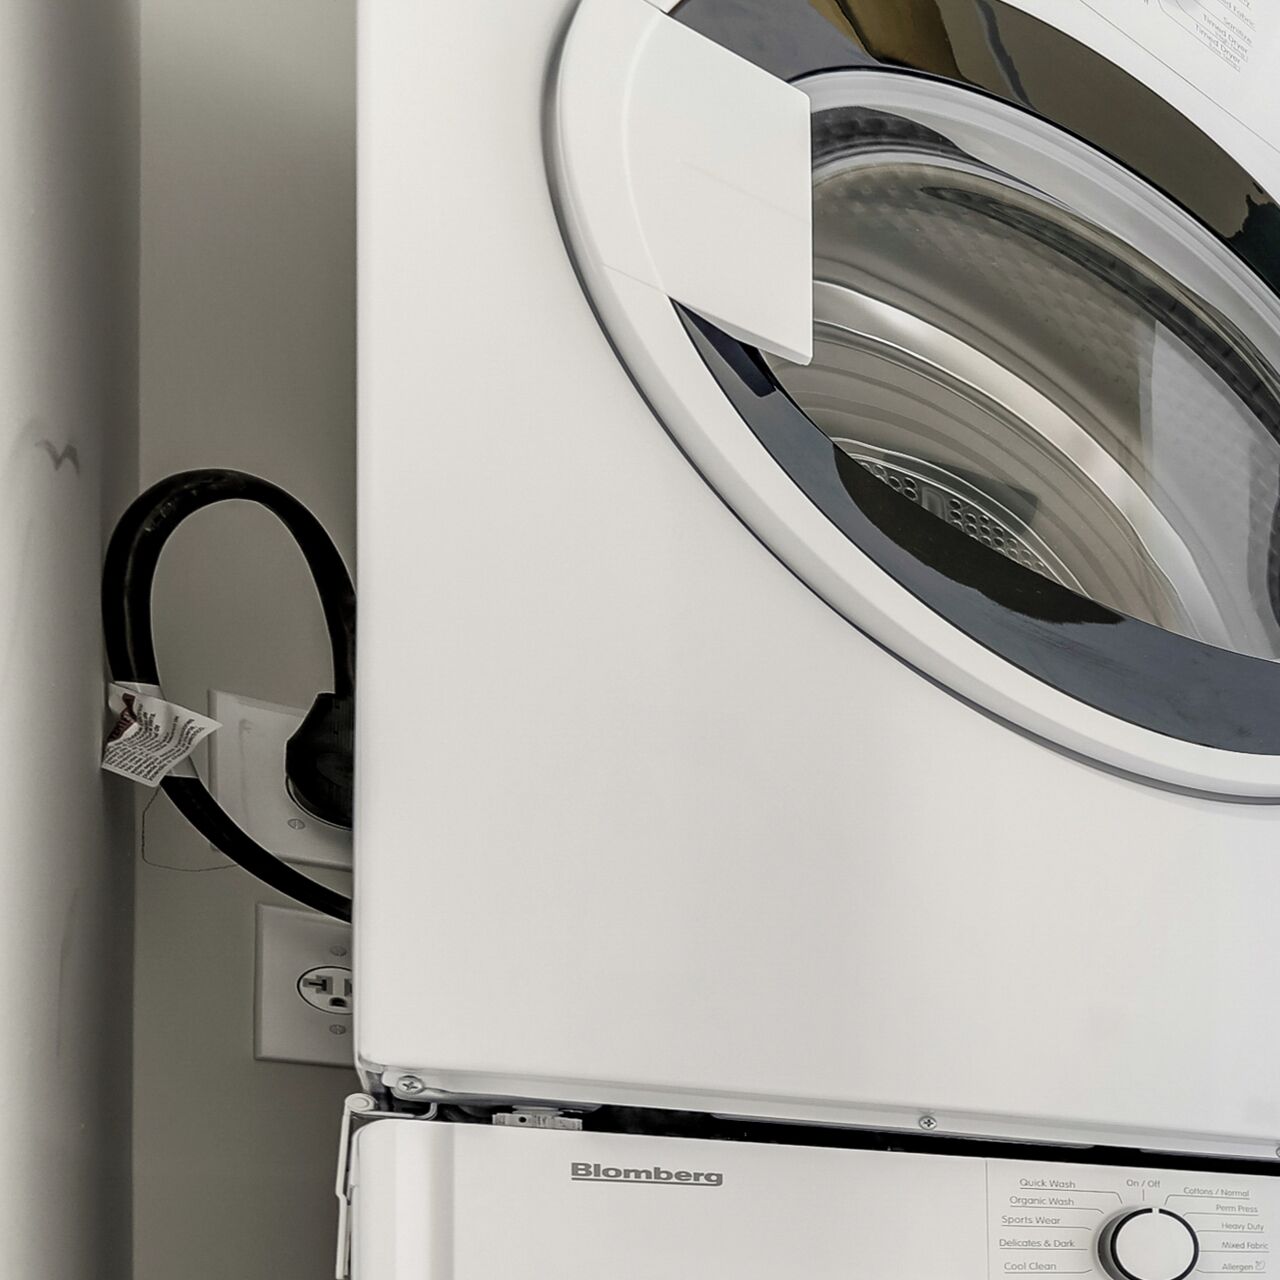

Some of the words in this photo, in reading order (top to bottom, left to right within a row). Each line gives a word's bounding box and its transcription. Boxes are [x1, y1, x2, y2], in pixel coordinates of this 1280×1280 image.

[1203, 14, 1227, 37] Timed
[1228, 34, 1248, 54] Dryer
[1195, 24, 1219, 47] Timed
[1220, 44, 1240, 63] Dryer
[571, 1162, 723, 1186] Blomberg
[1020, 1178, 1047, 1187] Quick
[1050, 1180, 1075, 1188] Wash
[1184, 1187, 1213, 1195] Cottons
[1221, 1189, 1249, 1197] Normal
[1010, 1196, 1047, 1206] Organic
[1049, 1197, 1074, 1206] Wash
[1216, 1204, 1236, 1212] Perm
[1238, 1205, 1258, 1213] Press
[1002, 1215, 1033, 1225] Sports
[1035, 1217, 1060, 1225] Wear
[1222, 1223, 1245, 1231] Heavy
[1247, 1223, 1264, 1231] Duty
[999, 1239, 1042, 1247] Delicates
[1004, 1262, 1026, 1270] Cool
[1029, 1262, 1056, 1270] Clean
[1222, 1263, 1253, 1272] Allergen
